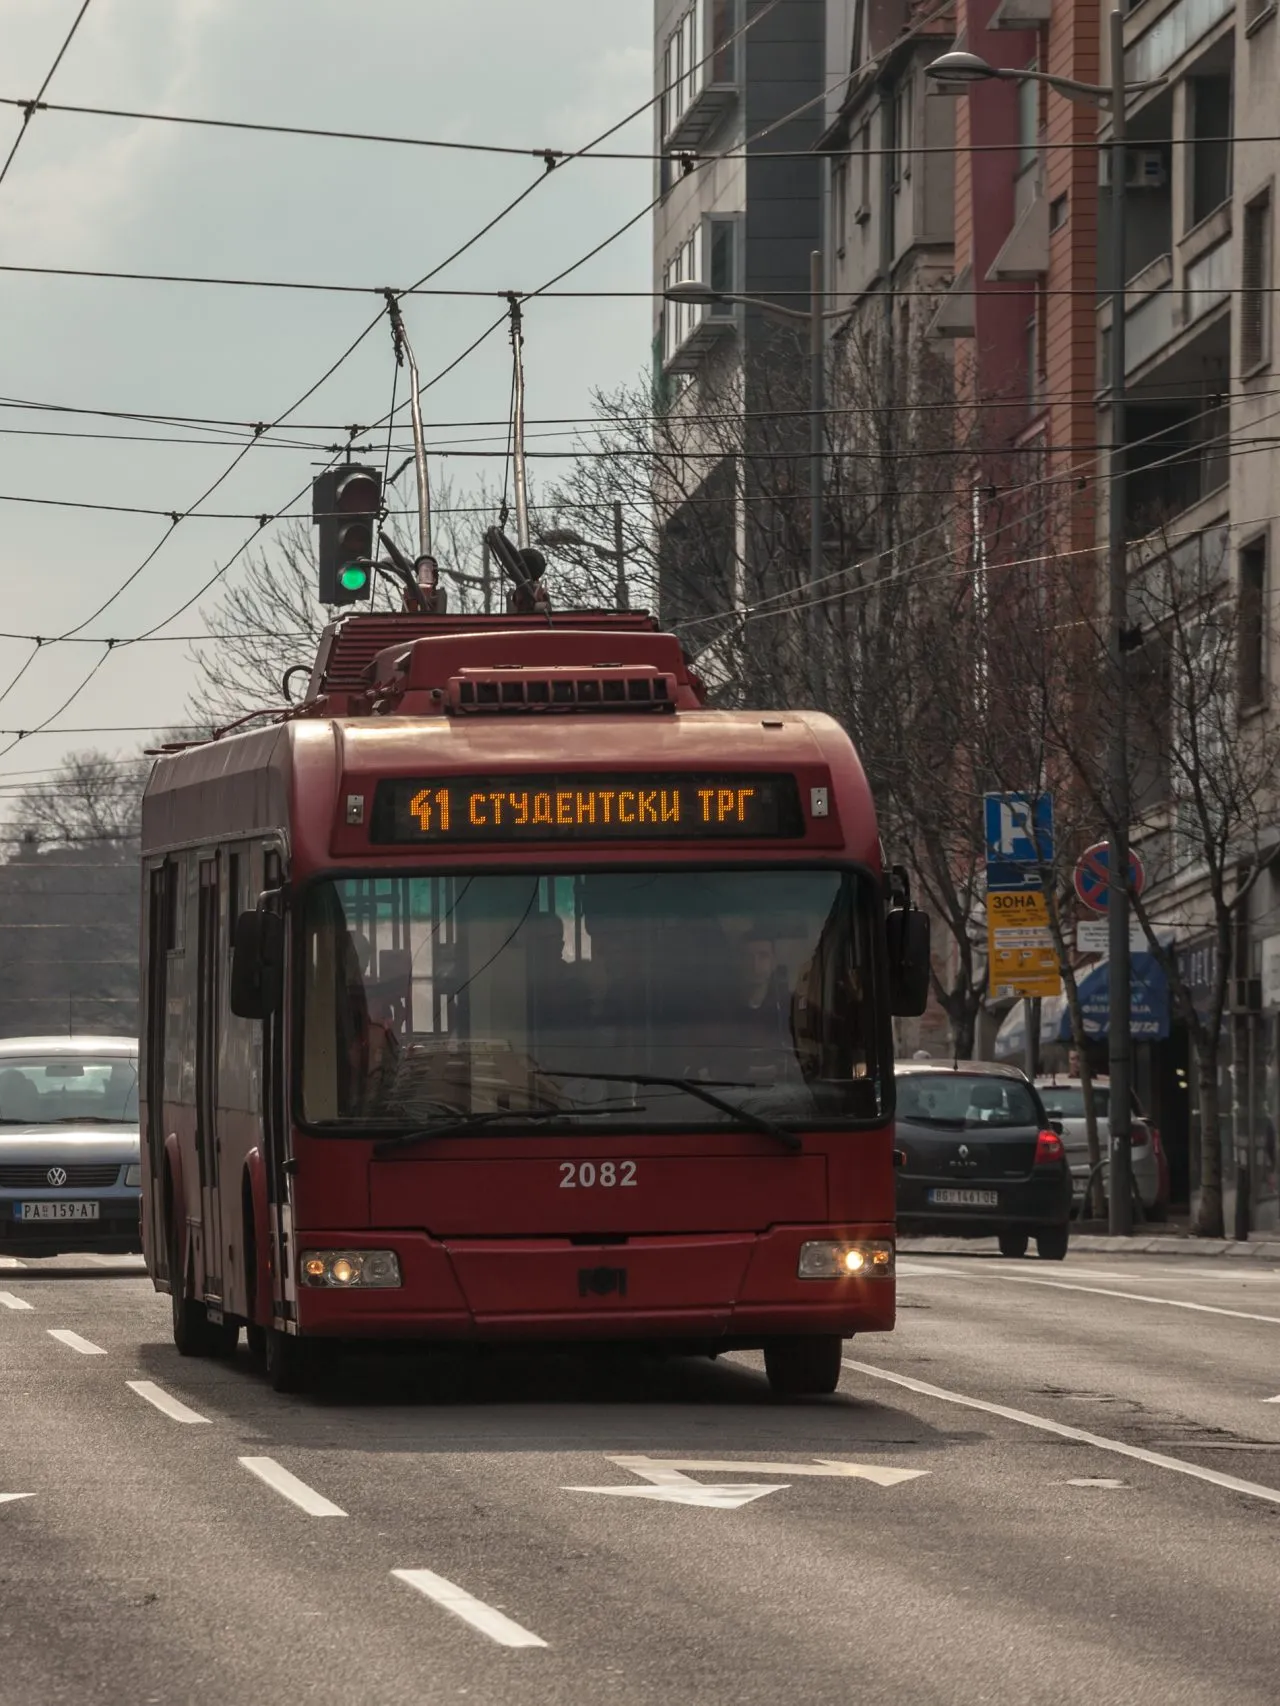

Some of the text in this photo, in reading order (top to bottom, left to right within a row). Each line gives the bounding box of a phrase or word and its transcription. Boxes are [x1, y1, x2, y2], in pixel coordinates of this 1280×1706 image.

[410, 788, 756, 831] 41 СТУДЕНТСКИ ТРГ
[993, 895, 1036, 909] ЗОНА
[559, 1160, 638, 1188] 2082
